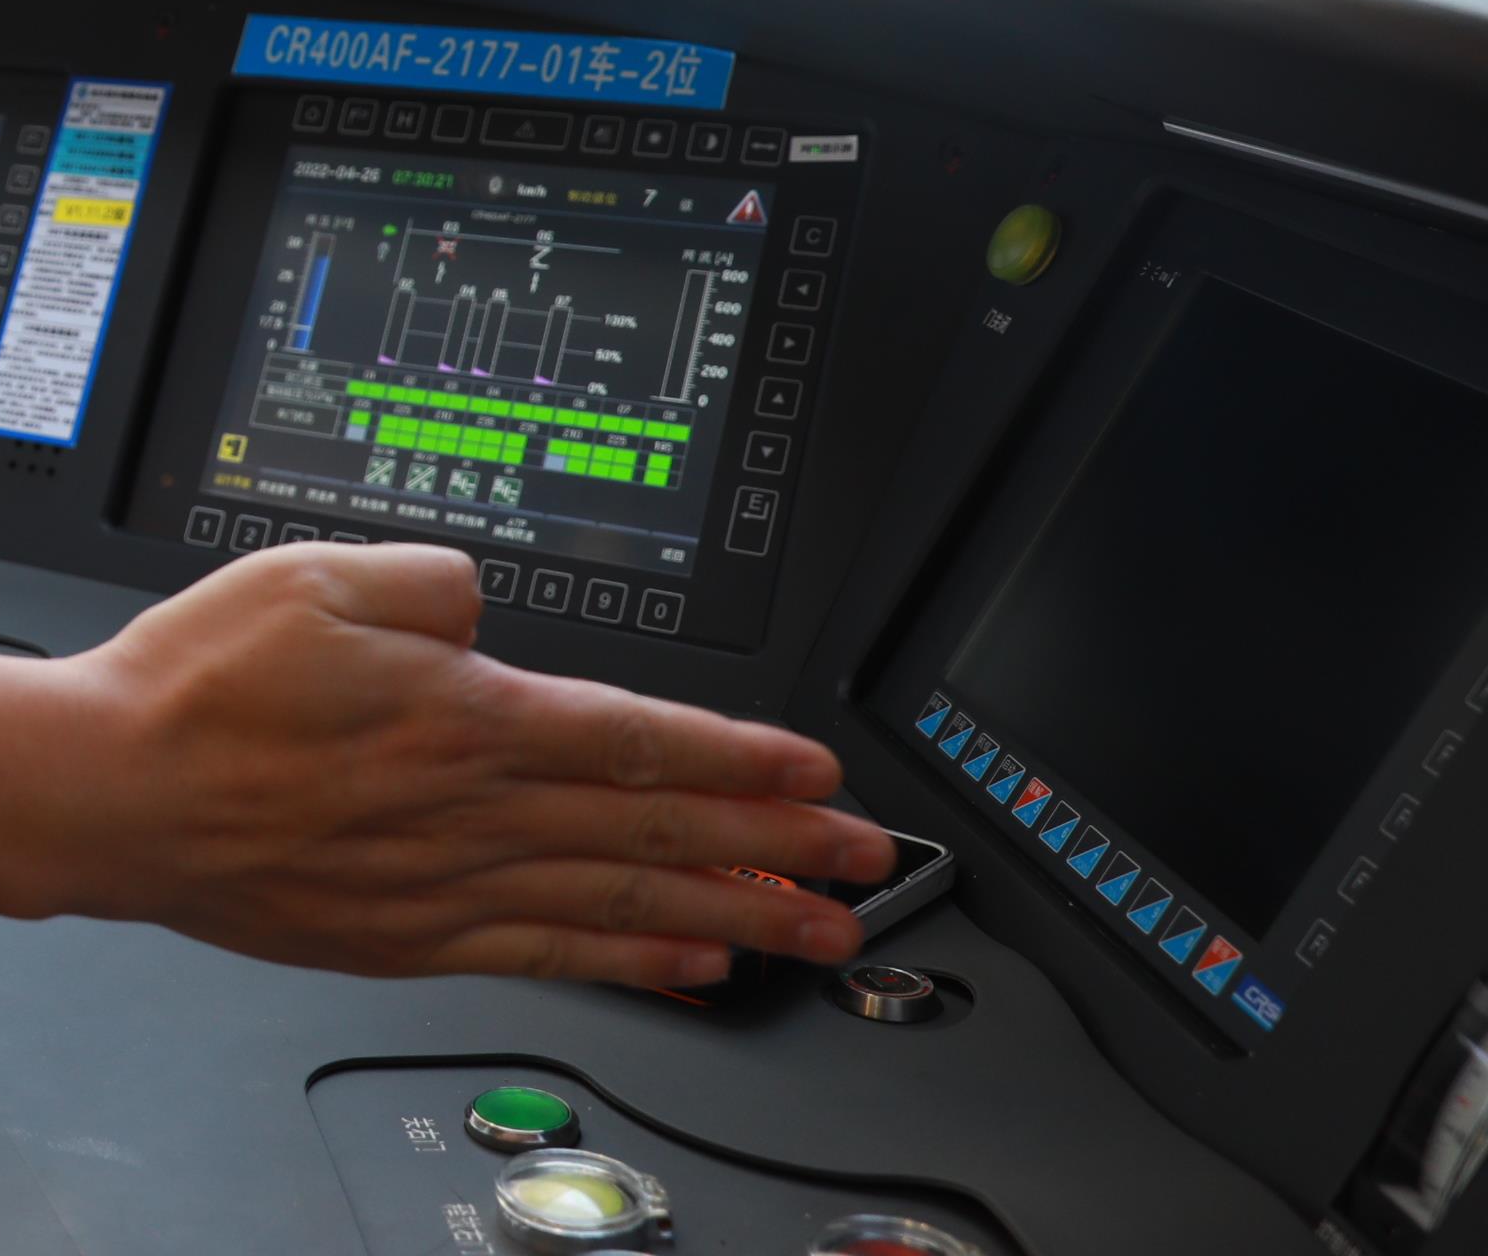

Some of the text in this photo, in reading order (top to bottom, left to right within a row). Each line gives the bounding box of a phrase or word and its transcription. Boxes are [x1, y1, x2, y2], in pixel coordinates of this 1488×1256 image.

[264, 24, 702, 98] CR400AF-2177-01车-2位
[642, 188, 659, 207] 7
[806, 227, 822, 245] C
[700, 364, 728, 379] 200
[198, 519, 668, 620] 1 2 7 8 9 0
